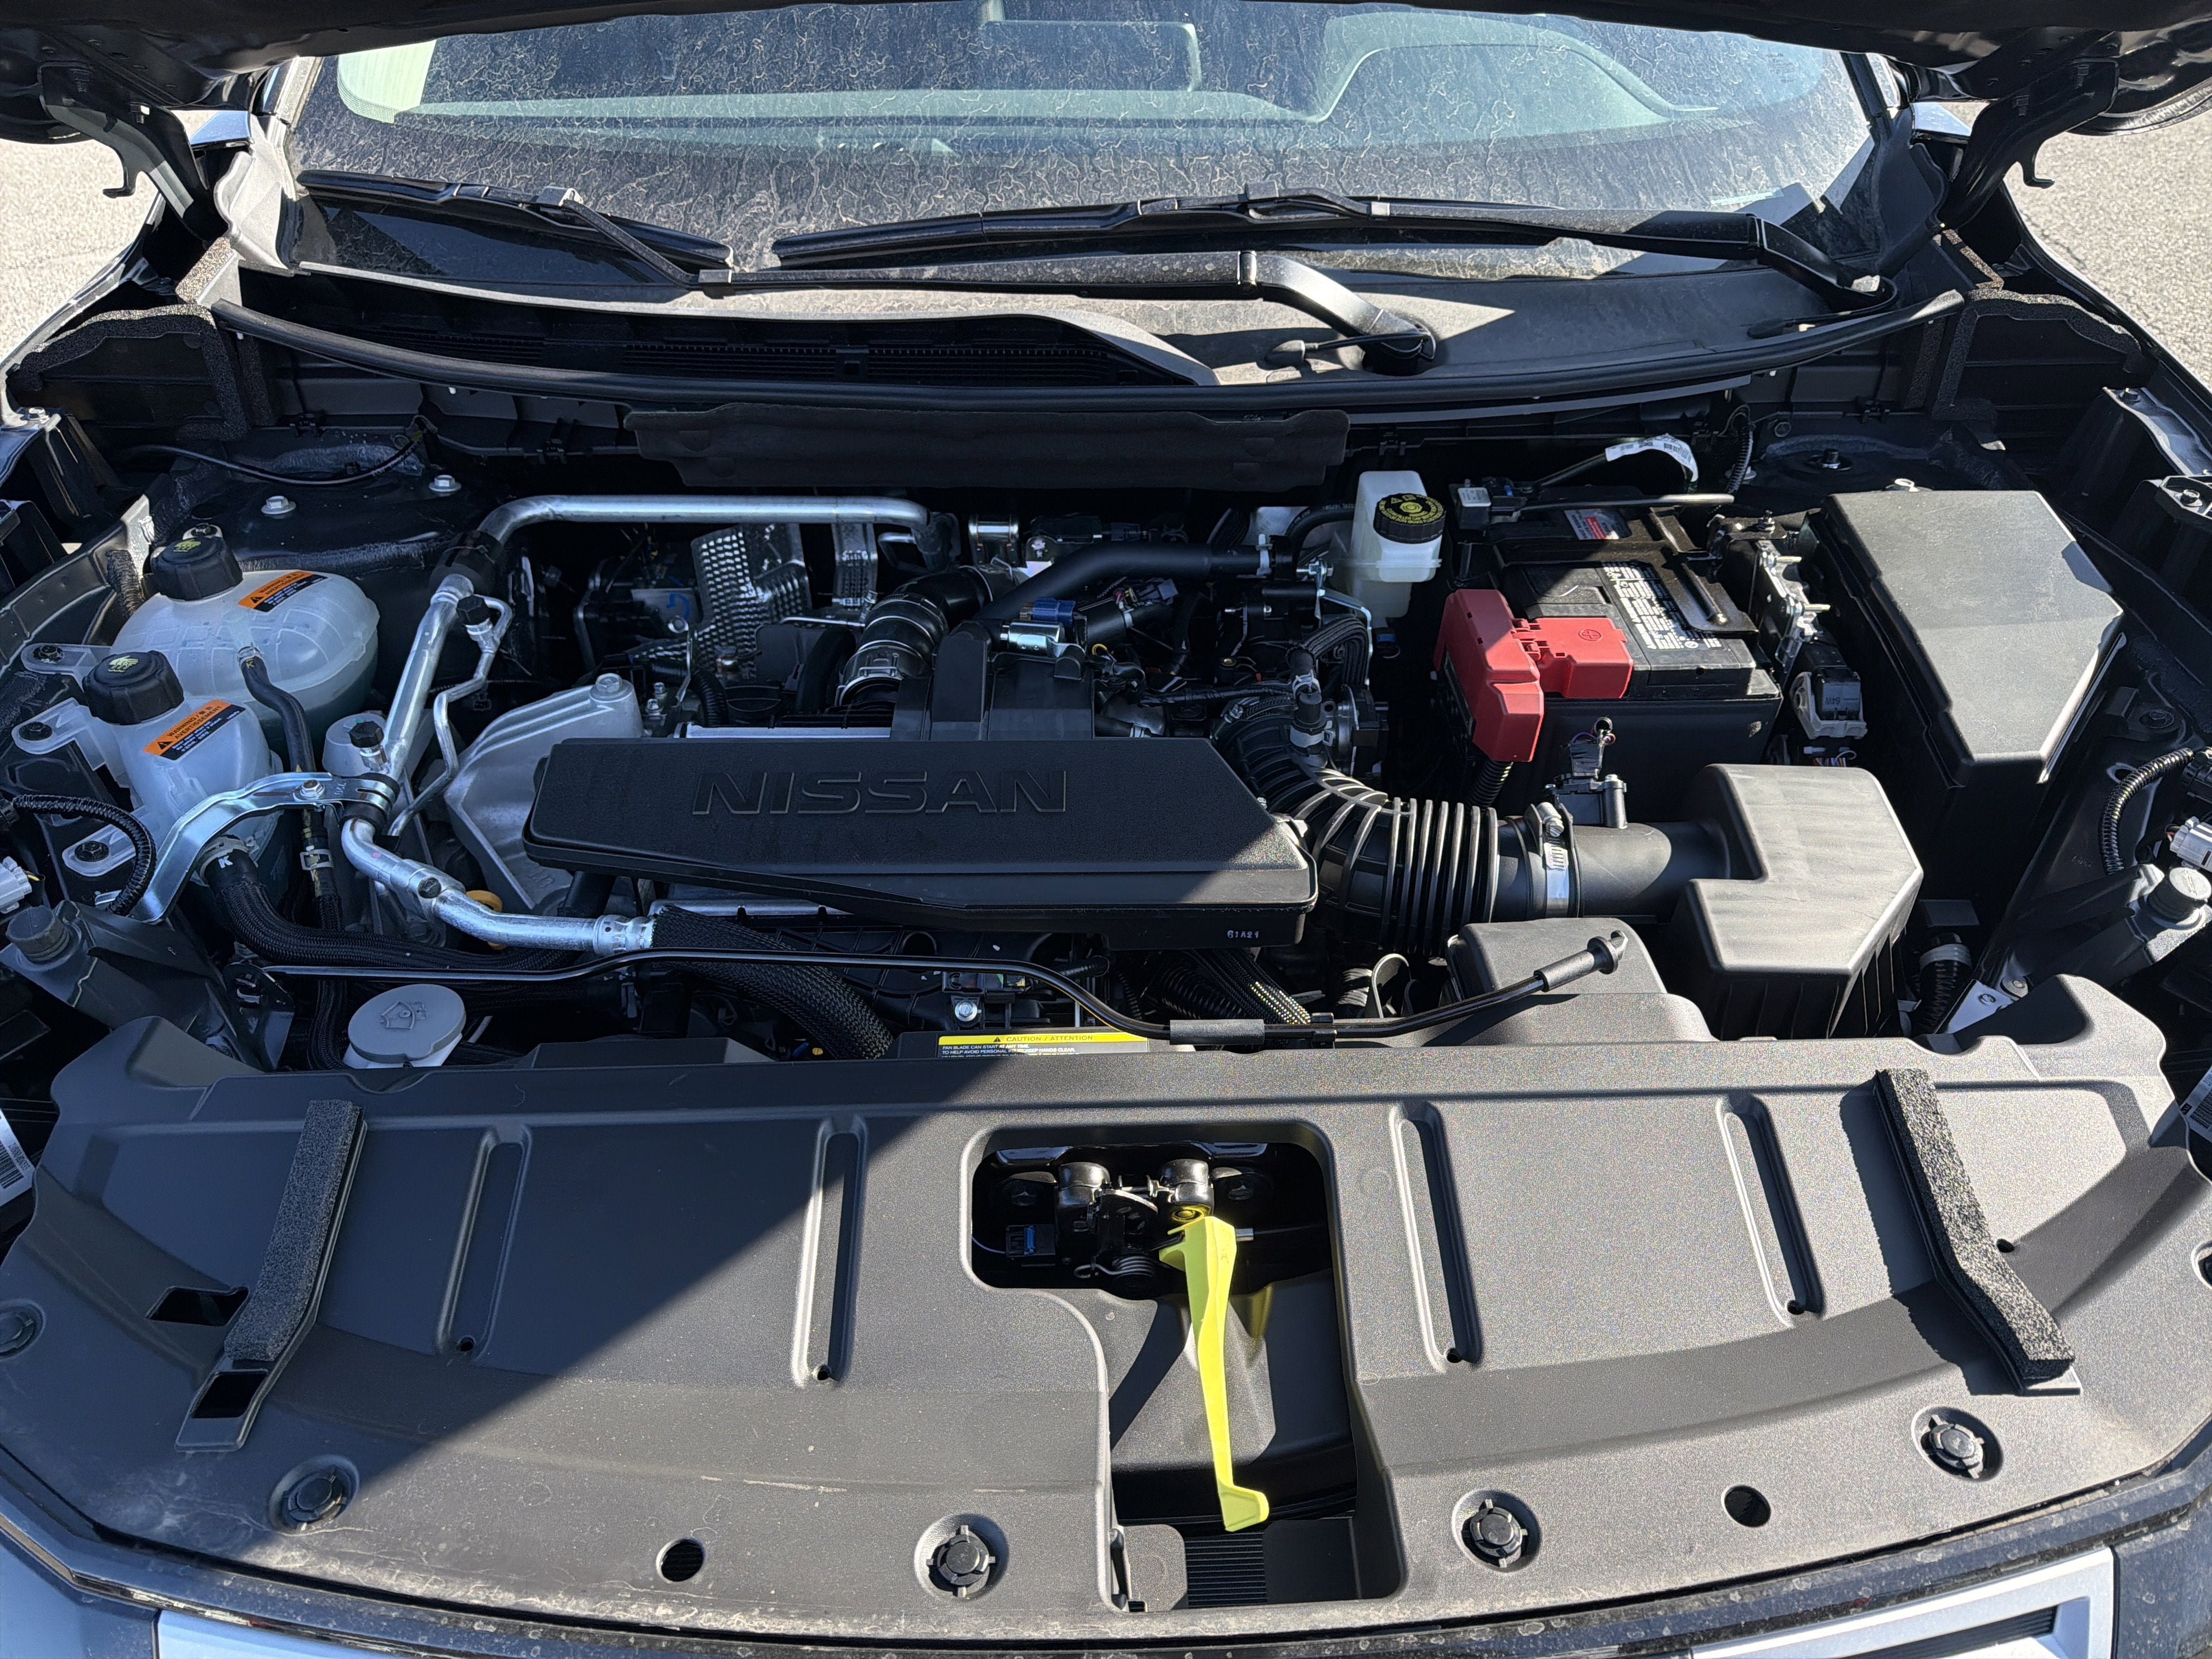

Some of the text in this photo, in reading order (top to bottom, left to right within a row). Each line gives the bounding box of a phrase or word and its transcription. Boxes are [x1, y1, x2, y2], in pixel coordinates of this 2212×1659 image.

[167, 717, 196, 737] WARNING
[174, 706, 222, 740] AVERTISSEMENT
[692, 771, 1066, 815] NISSAN
[218, 855, 233, 869] K
